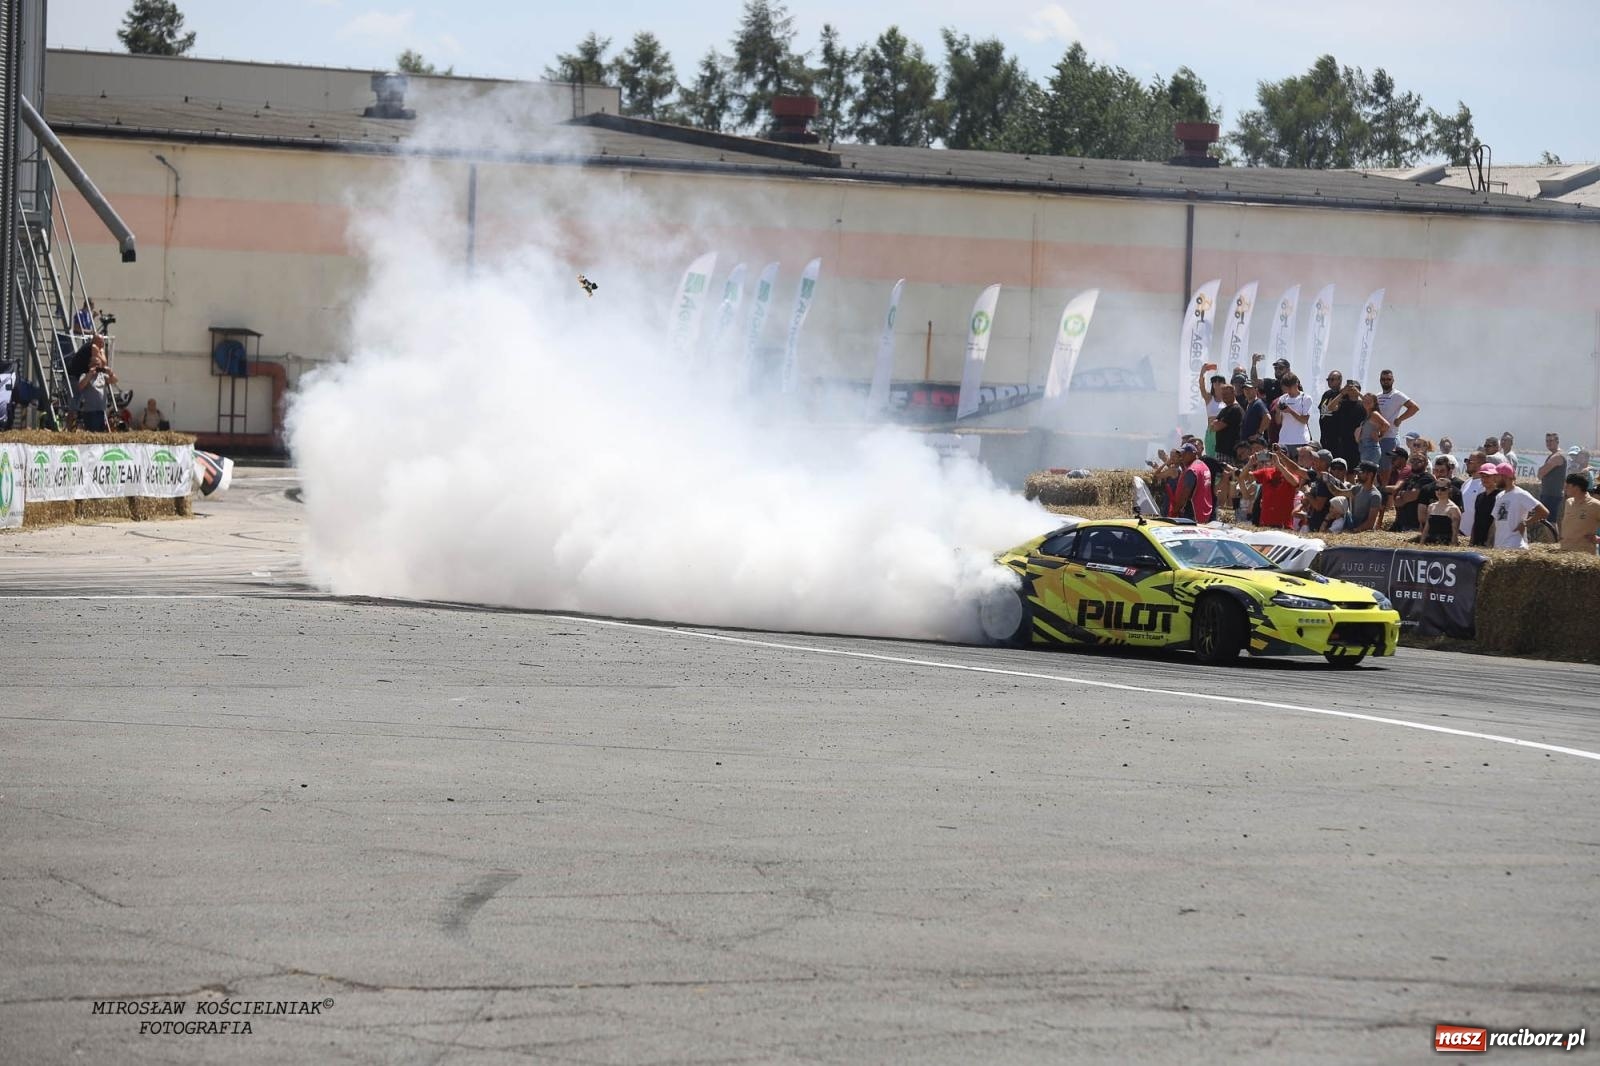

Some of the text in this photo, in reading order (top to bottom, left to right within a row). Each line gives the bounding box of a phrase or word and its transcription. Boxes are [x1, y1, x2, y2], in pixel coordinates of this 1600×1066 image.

[1341, 562, 1386, 572] AUTO FUS
[1396, 559, 1457, 587] INEOS
[1077, 598, 1179, 634] PILOT
